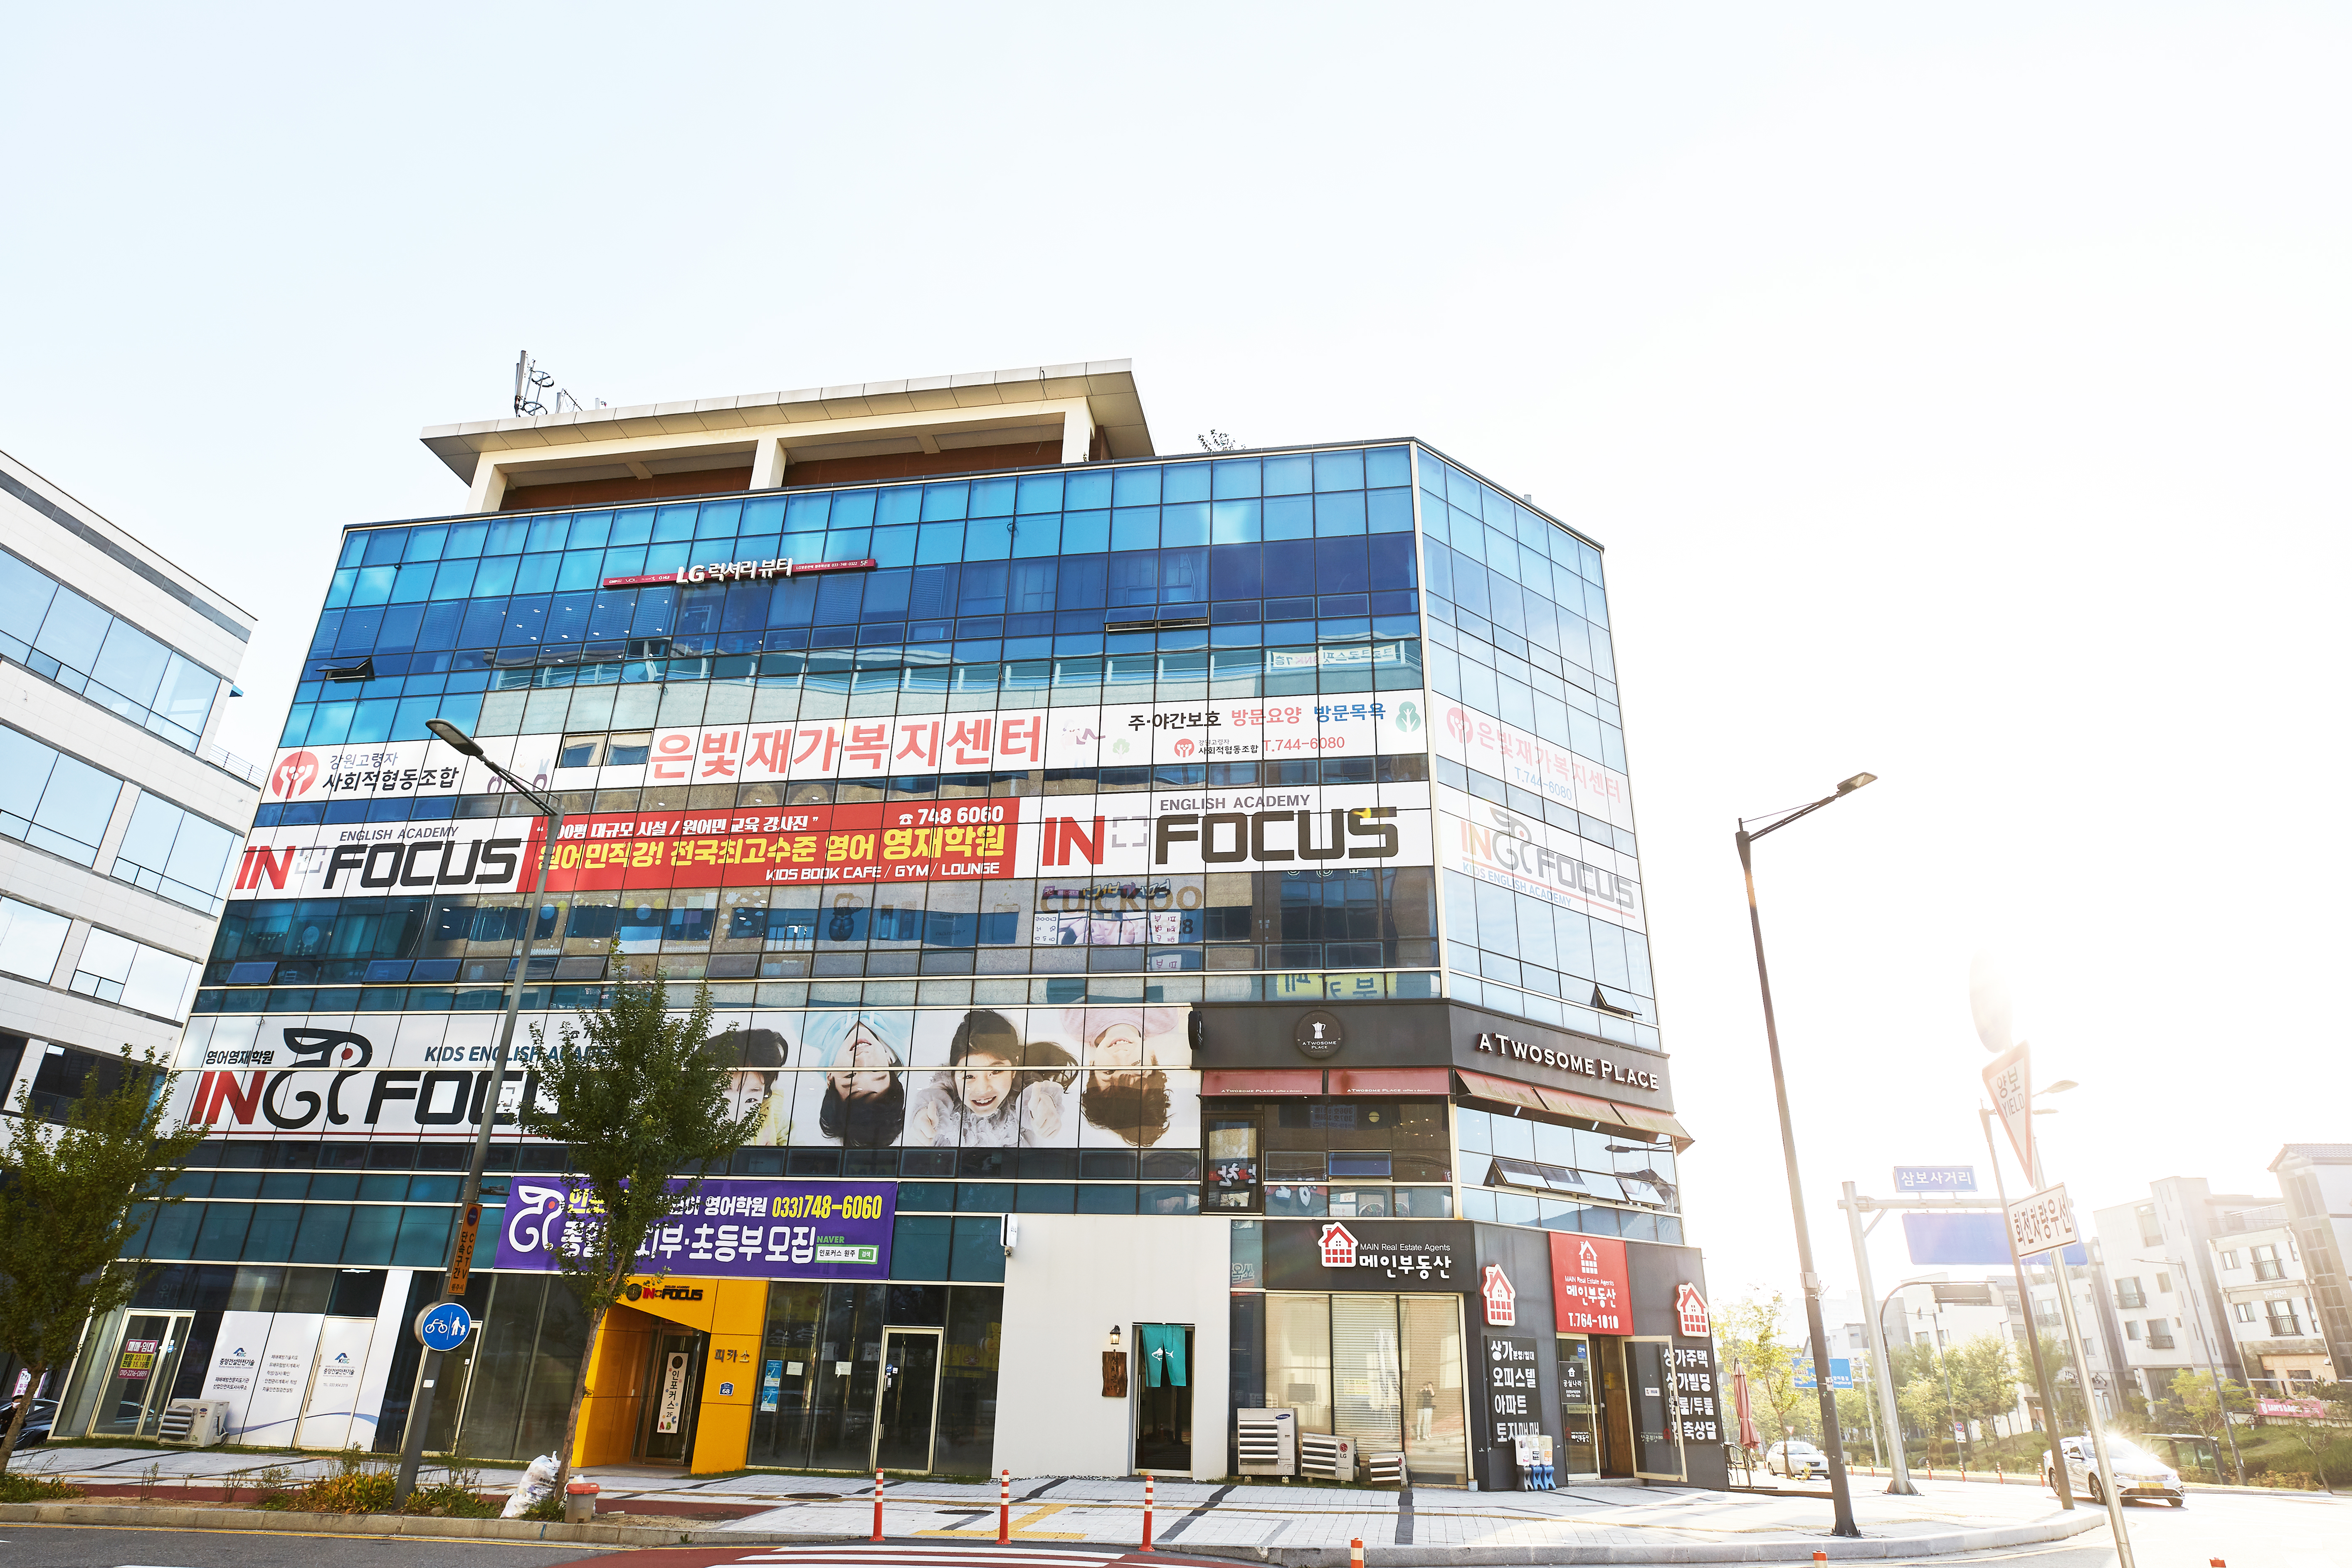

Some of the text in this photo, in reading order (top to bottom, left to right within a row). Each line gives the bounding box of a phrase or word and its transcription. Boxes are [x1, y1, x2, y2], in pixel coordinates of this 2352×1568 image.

[676, 557, 793, 584] LG 럭셔리 뷰티
[1232, 707, 1302, 726] 방문요양
[1314, 703, 1386, 723] 방문목욕
[651, 715, 1042, 780] 은빛재가복지센터
[1198, 744, 1259, 755] 사회적협동조합
[1263, 736, 1345, 753] T.744-6080
[330, 752, 399, 770] 강원고령자
[1476, 721, 1621, 805] 은빛재가복지센터
[322, 766, 459, 792] 사회적협동조합
[1514, 767, 1572, 801] T.744-6080
[1160, 794, 1311, 810] ENGLISH ACADEMY
[545, 823, 587, 840] 00평
[590, 822, 634, 838] 대규모
[636, 820, 667, 836] 시설
[682, 818, 727, 835] 원어민
[730, 817, 759, 832] 교육
[763, 815, 808, 832] 강사진
[918, 806, 1004, 825] 748 6060
[339, 826, 459, 842] ENGLISH ACADEMY
[671, 836, 817, 866] 전국최고수준
[825, 834, 875, 861] 영어
[883, 824, 1004, 860] 영재학원
[1042, 806, 1399, 867] IN FOCUS
[234, 837, 522, 890] IN FOCUS
[765, 868, 799, 881] KIDS
[801, 867, 841, 879] BOOK
[843, 866, 882, 878] CAFE
[895, 864, 929, 877] GYM
[941, 862, 1000, 876] LOUNGE
[1460, 820, 1635, 910] IN FOCUS
[1463, 861, 1572, 908] KIDS ENGLISH ACADEMY
[1040, 885, 1203, 914] CUCKOO
[205, 1049, 275, 1065] 영어영재학원
[424, 1046, 465, 1062] KIDS
[1478, 1032, 1660, 1091] A TWOSOME PLACE
[1996, 1066, 2021, 1099] 양보
[189, 1070, 268, 1125] IN
[2002, 1093, 2025, 1119] YIELD
[1901, 1171, 1972, 1187] 삼보사거리
[704, 1194, 883, 1220] 영어학원 033)748-6060
[2014, 1193, 2073, 1247] 회전차량우선
[765, 1225, 817, 1264] 모집
[817, 1235, 845, 1244] NAVER
[1424, 1243, 1451, 1252] Agents
[453, 1231, 468, 1279] 단속구간
[462, 1233, 474, 1279] CCTV
[1358, 1254, 1452, 1280] 메인부동산
[642, 1287, 703, 1301] IN FOCUS
[1566, 1284, 1617, 1309] 메인부동산
[1568, 1311, 1619, 1330] T.764-1010
[714, 1349, 750, 1363] 피카소
[1490, 1340, 1513, 1361] 상가
[1663, 1348, 1709, 1368] 상가주택
[1493, 1366, 1536, 1388] 오피스텔
[1563, 1379, 1582, 1388] 공실나라
[1666, 1372, 1711, 1393] 상가빌딩
[666, 1370, 680, 1410] 인포커스
[1494, 1394, 1528, 1415] 아파트
